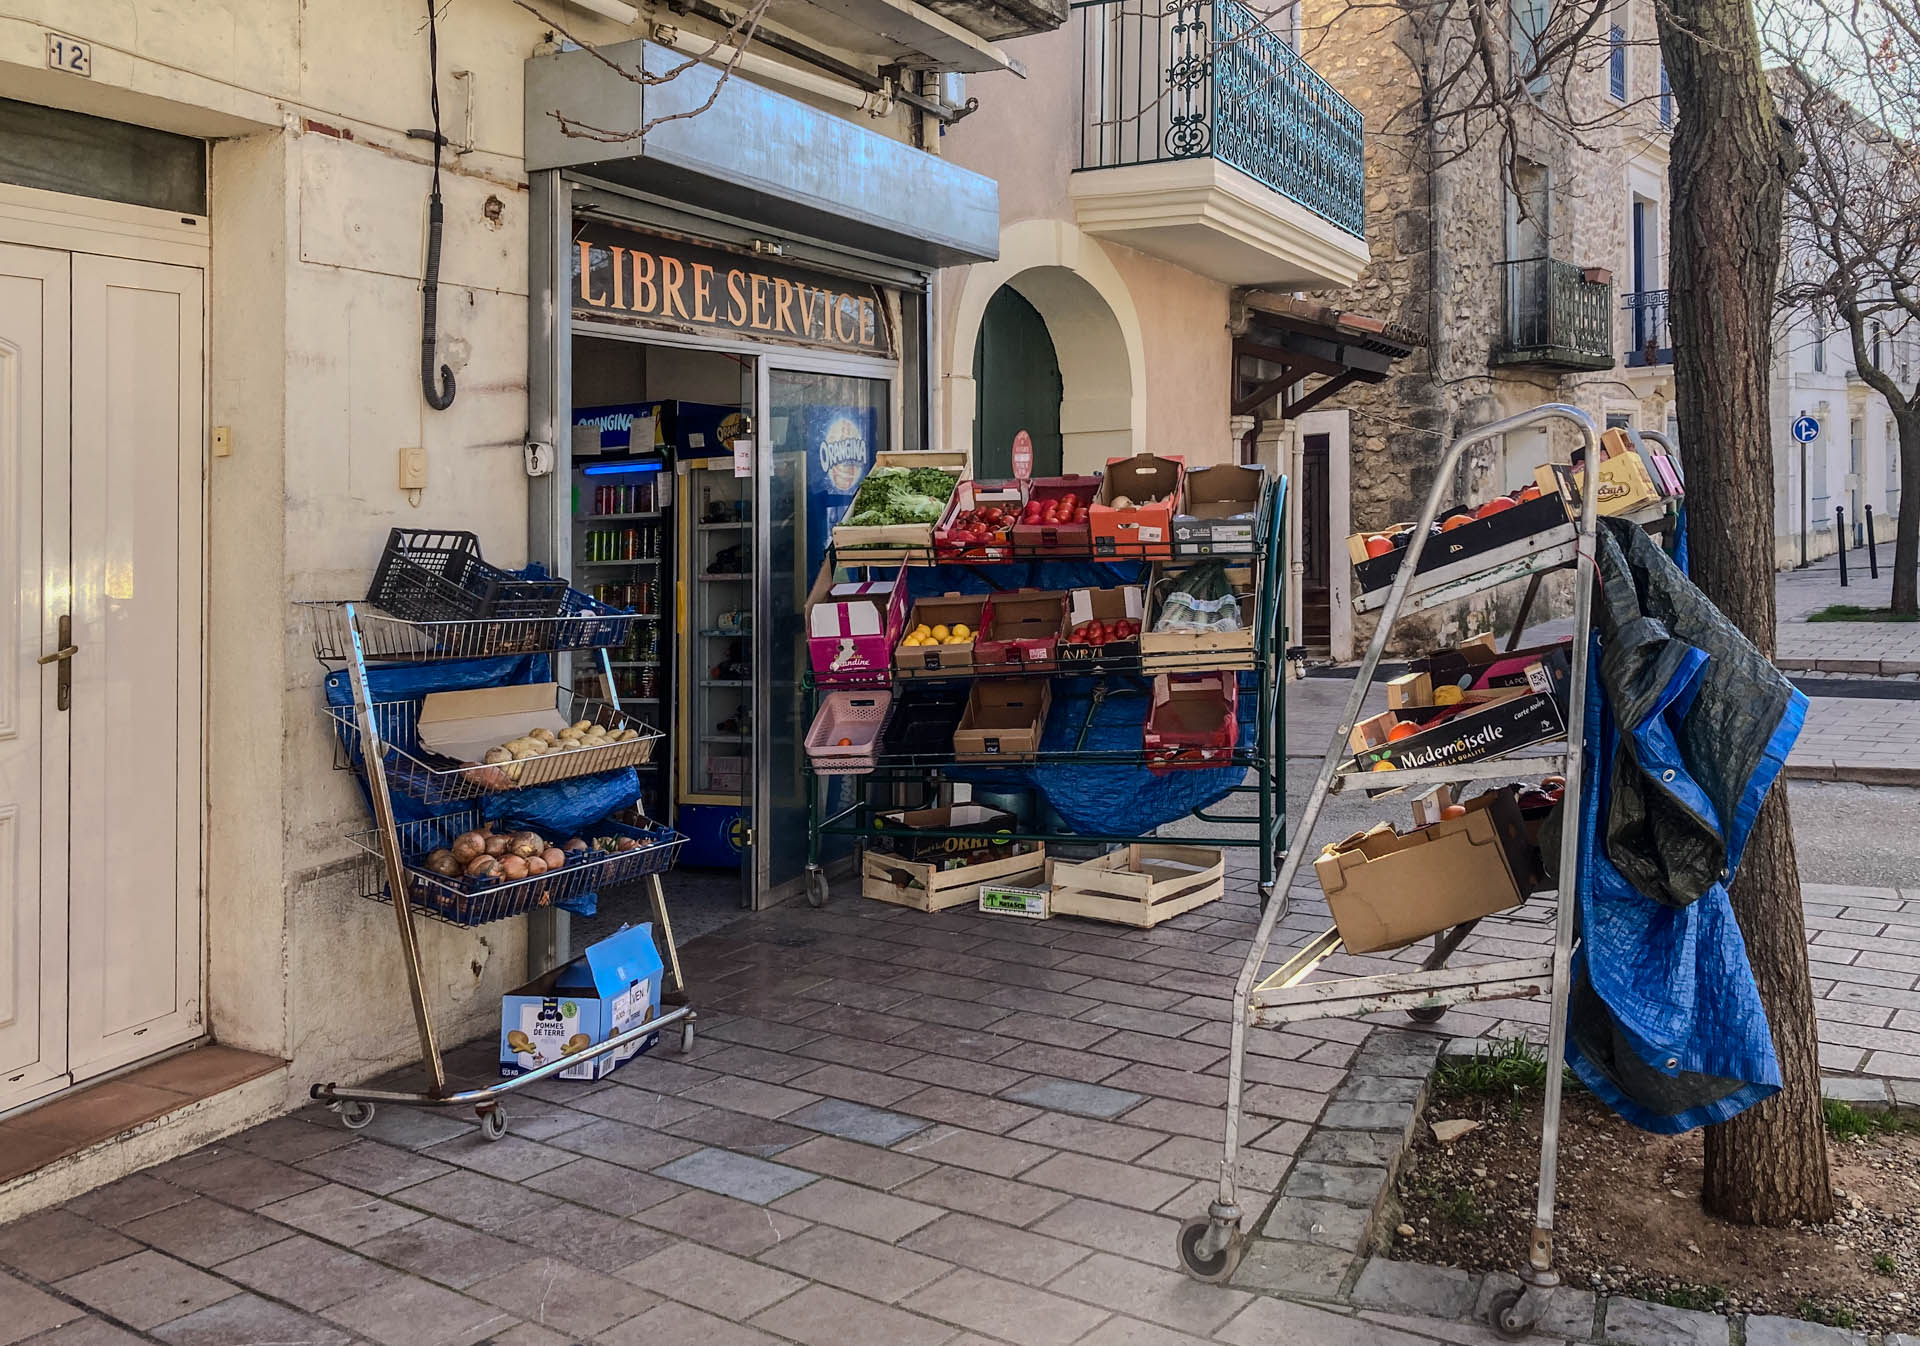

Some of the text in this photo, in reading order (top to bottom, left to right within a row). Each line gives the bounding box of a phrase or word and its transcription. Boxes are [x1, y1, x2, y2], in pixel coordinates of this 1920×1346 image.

[56, 41, 83, 71] 12
[575, 239, 876, 347] LIBRE SERVICE
[819, 437, 867, 473] ORANGINA
[1400, 723, 1504, 770] Mademoiselle
[533, 1028, 566, 1037] DE TERRE
[535, 1022, 564, 1030] POMMES
